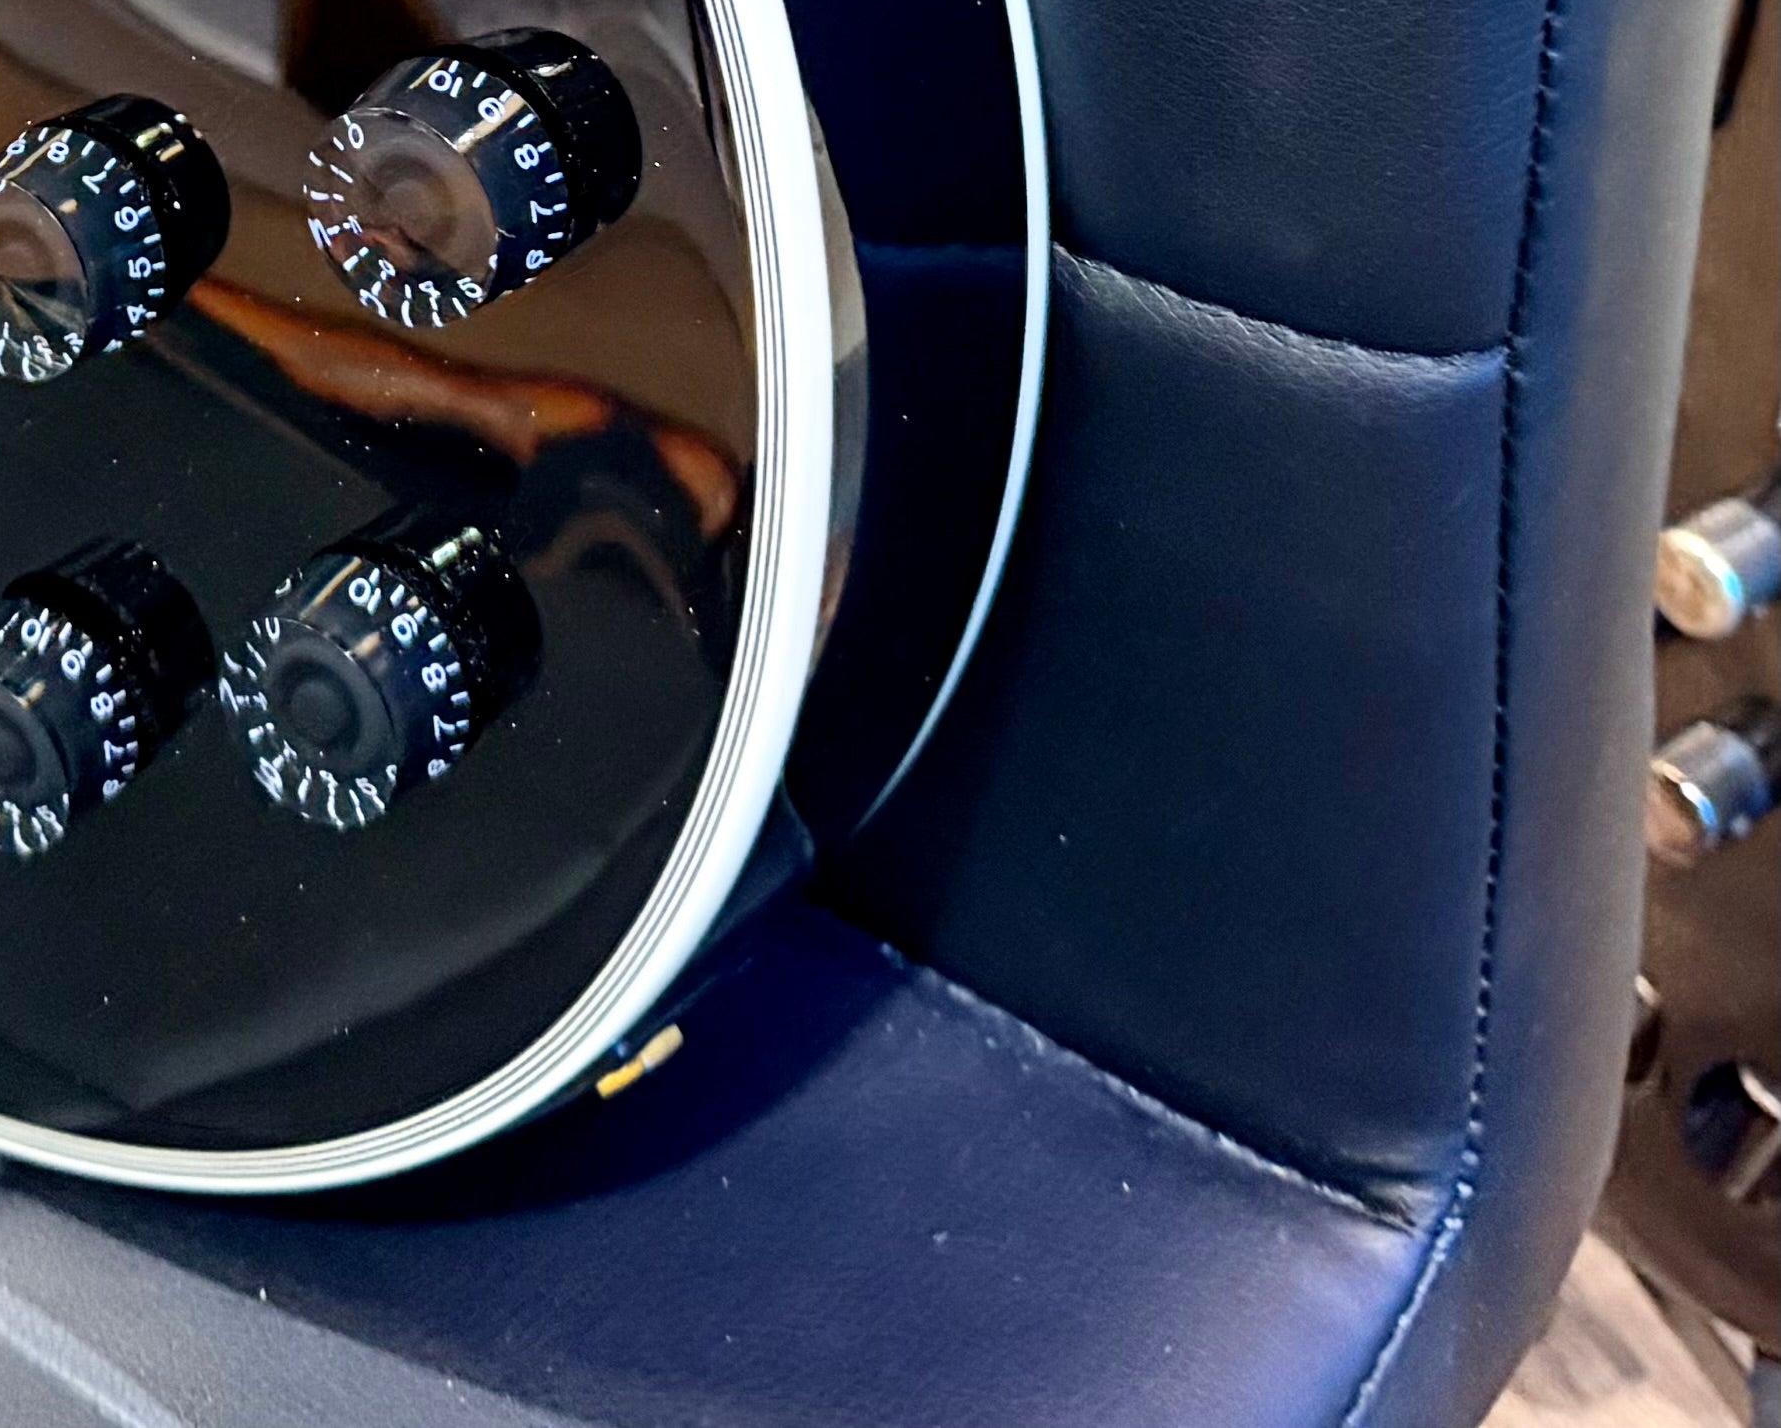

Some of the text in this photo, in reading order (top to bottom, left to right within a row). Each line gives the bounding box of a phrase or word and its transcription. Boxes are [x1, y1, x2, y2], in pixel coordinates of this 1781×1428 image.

[46, 141, 70, 164] 8
[513, 143, 540, 171] 8
[529, 199, 554, 224] 7
[127, 255, 153, 280] 5
[125, 303, 147, 325] 4
[420, 662, 447, 694] 8
[90, 691, 115, 724] 8
